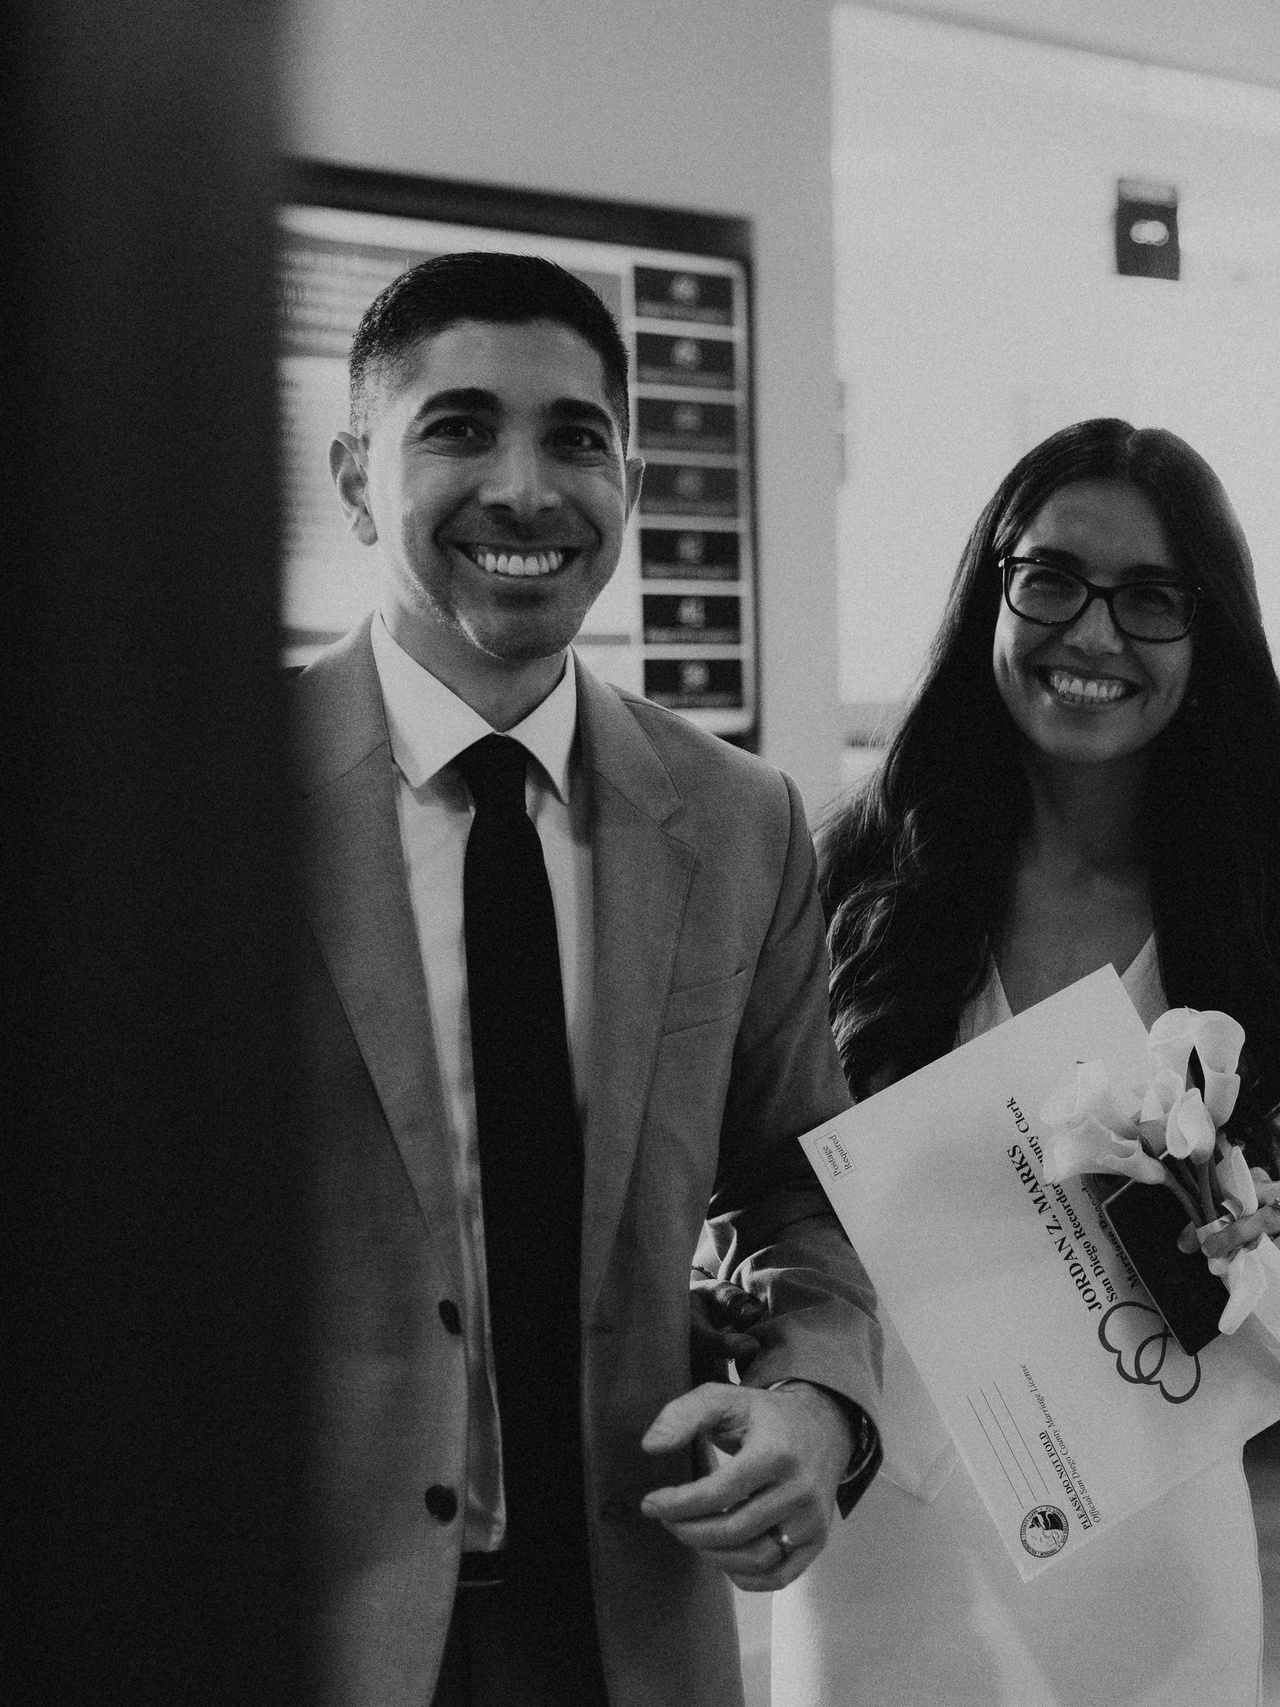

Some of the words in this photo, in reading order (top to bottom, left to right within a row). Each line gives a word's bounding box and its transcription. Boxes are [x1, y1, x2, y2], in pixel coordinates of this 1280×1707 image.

[1007, 1097, 1029, 1133] Clerk
[823, 1146, 841, 1176] Postage
[829, 1135, 852, 1170] Required
[1007, 1145, 1052, 1215] MARKS
[1046, 1215, 1063, 1235] Z.
[1083, 1241, 1105, 1278] Diego
[1054, 1236, 1102, 1312] JORDAN
[1102, 1277, 1118, 1302] San
[1021, 1365, 1038, 1392] License
[1035, 1393, 1055, 1428] Marriage
[1039, 1432, 1058, 1458] FOLD
[1052, 1430, 1068, 1455] County
[1051, 1458, 1068, 1479] NOT
[1066, 1457, 1081, 1479] Diego
[1062, 1479, 1074, 1494] DO
[1077, 1480, 1087, 1494] San
[1069, 1494, 1092, 1530] PLEASE
[1082, 1495, 1101, 1523] Official
